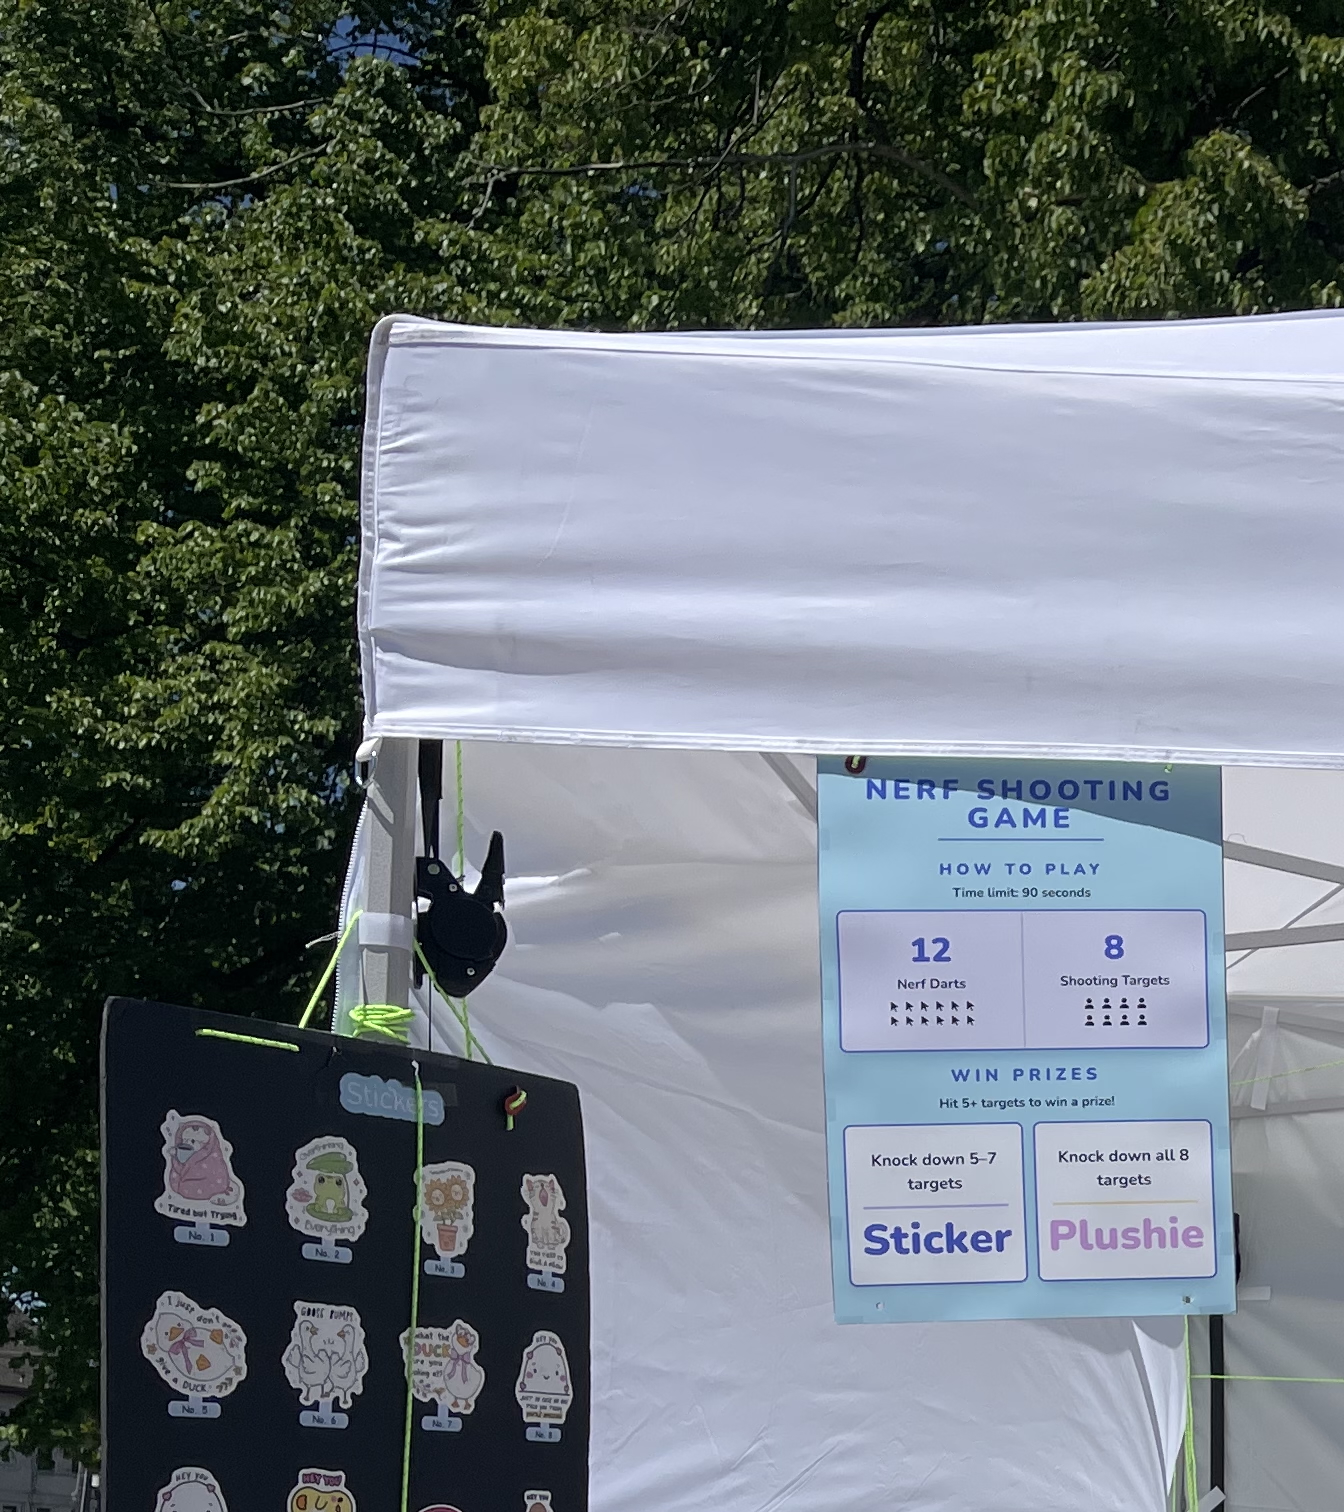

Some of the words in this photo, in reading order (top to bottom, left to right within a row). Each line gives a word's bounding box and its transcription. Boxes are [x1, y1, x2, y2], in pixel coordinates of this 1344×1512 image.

[865, 778, 959, 800] NERF
[976, 779, 1171, 802] SHOOTING
[967, 807, 1071, 829] GAME
[939, 862, 992, 876] HOW
[1005, 862, 1033, 876] TO
[1046, 862, 1102, 876] PLAY
[952, 886, 985, 899] Time
[987, 886, 1019, 899] limit:
[1022, 886, 1038, 899] 90
[1041, 886, 1092, 899] seconds
[911, 936, 952, 964] 12
[1104, 934, 1125, 961] 8
[897, 977, 927, 990] Nerf
[930, 977, 967, 990] Darts
[1060, 974, 1118, 989] Shooting
[1121, 974, 1171, 989] Targets
[951, 1068, 999, 1082] WIN
[1013, 1067, 1099, 1082] PRIZES
[939, 1097, 958, 1110] Hit
[961, 1097, 978, 1110] 5+
[980, 1097, 1026, 1111] targets
[1029, 1096, 1042, 1108] to
[1044, 1096, 1068, 1108] win
[1071, 1098, 1079, 1108] a
[1082, 1095, 1115, 1110] prize!
[871, 1153, 918, 1167] Knock
[922, 1152, 965, 1166] down
[1058, 1149, 1104, 1164] Knock
[1108, 1149, 1151, 1163] down
[1155, 1148, 1176, 1162] all
[1179, 1148, 1190, 1162] 8
[907, 1176, 963, 1192] targets
[1097, 1173, 1151, 1189] targets
[168, 1203, 190, 1216] Tired
[210, 1210, 238, 1222] Trying
[188, 1230, 204, 1241] No.
[210, 1233, 215, 1242] 1
[304, 1219, 356, 1237] Everything
[1049, 1215, 1205, 1251] Plushie
[863, 1221, 1013, 1256] Sticker
[315, 1248, 331, 1258] No.
[334, 1251, 340, 1259] 2
[167, 1296, 172, 1306] I
[174, 1299, 195, 1314] just
[196, 1315, 220, 1325] don't
[155, 1356, 171, 1375] give
[182, 1380, 207, 1392] DUCK
[181, 1405, 196, 1414] No.
[202, 1405, 208, 1414] 5
[312, 1415, 327, 1424] No.
[331, 1416, 337, 1425] 6
[302, 1472, 322, 1485] HEY
[322, 1474, 342, 1486] YOU
